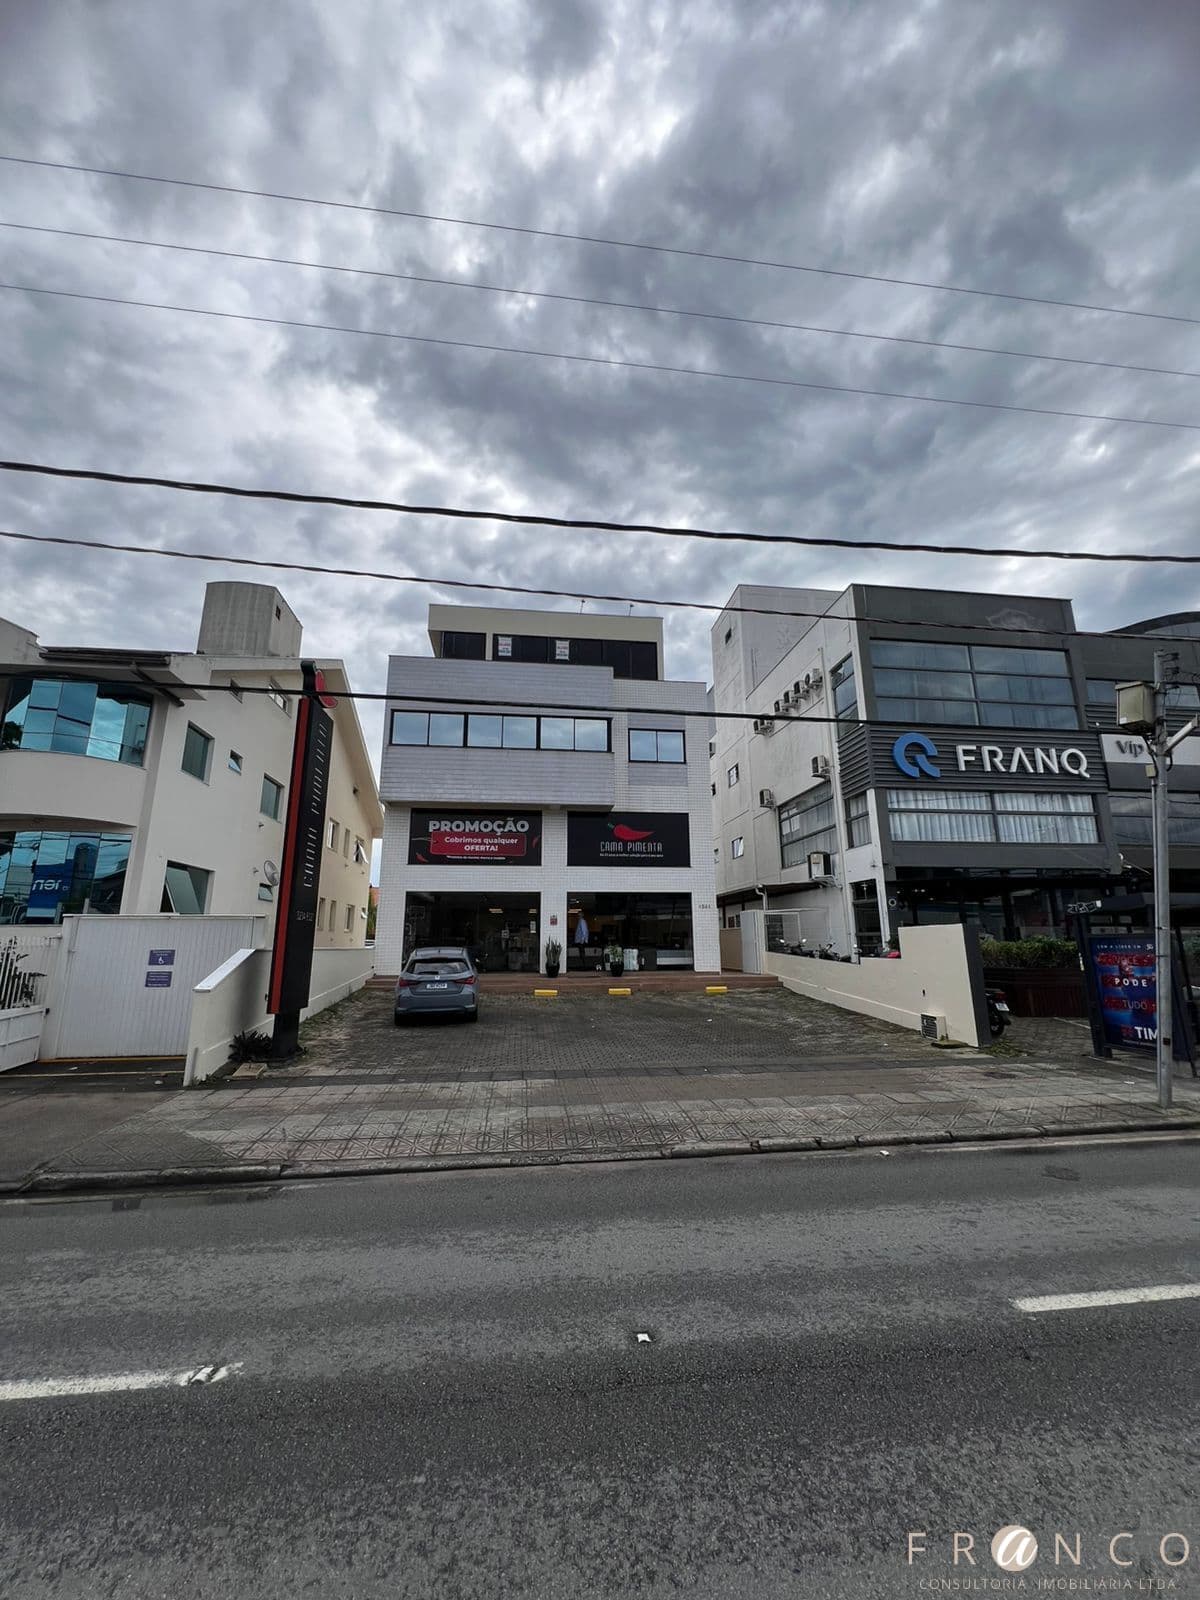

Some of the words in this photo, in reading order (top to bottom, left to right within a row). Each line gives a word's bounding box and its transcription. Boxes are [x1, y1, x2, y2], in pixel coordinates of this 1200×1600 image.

[1115, 740, 1145, 758] Vip
[956, 744, 1091, 779] FRANQ
[428, 817, 529, 836] PROMOÇÃO
[444, 836, 482, 844] Cobrimos
[483, 837, 519, 846] qualquer
[600, 841, 623, 853] CAMA
[627, 841, 663, 853] PIMENTA
[464, 844, 499, 852] OFERTA!
[1114, 977, 1148, 988] PODE
[1122, 999, 1147, 1010] TUDO
[1134, 1026, 1159, 1041] TIM
